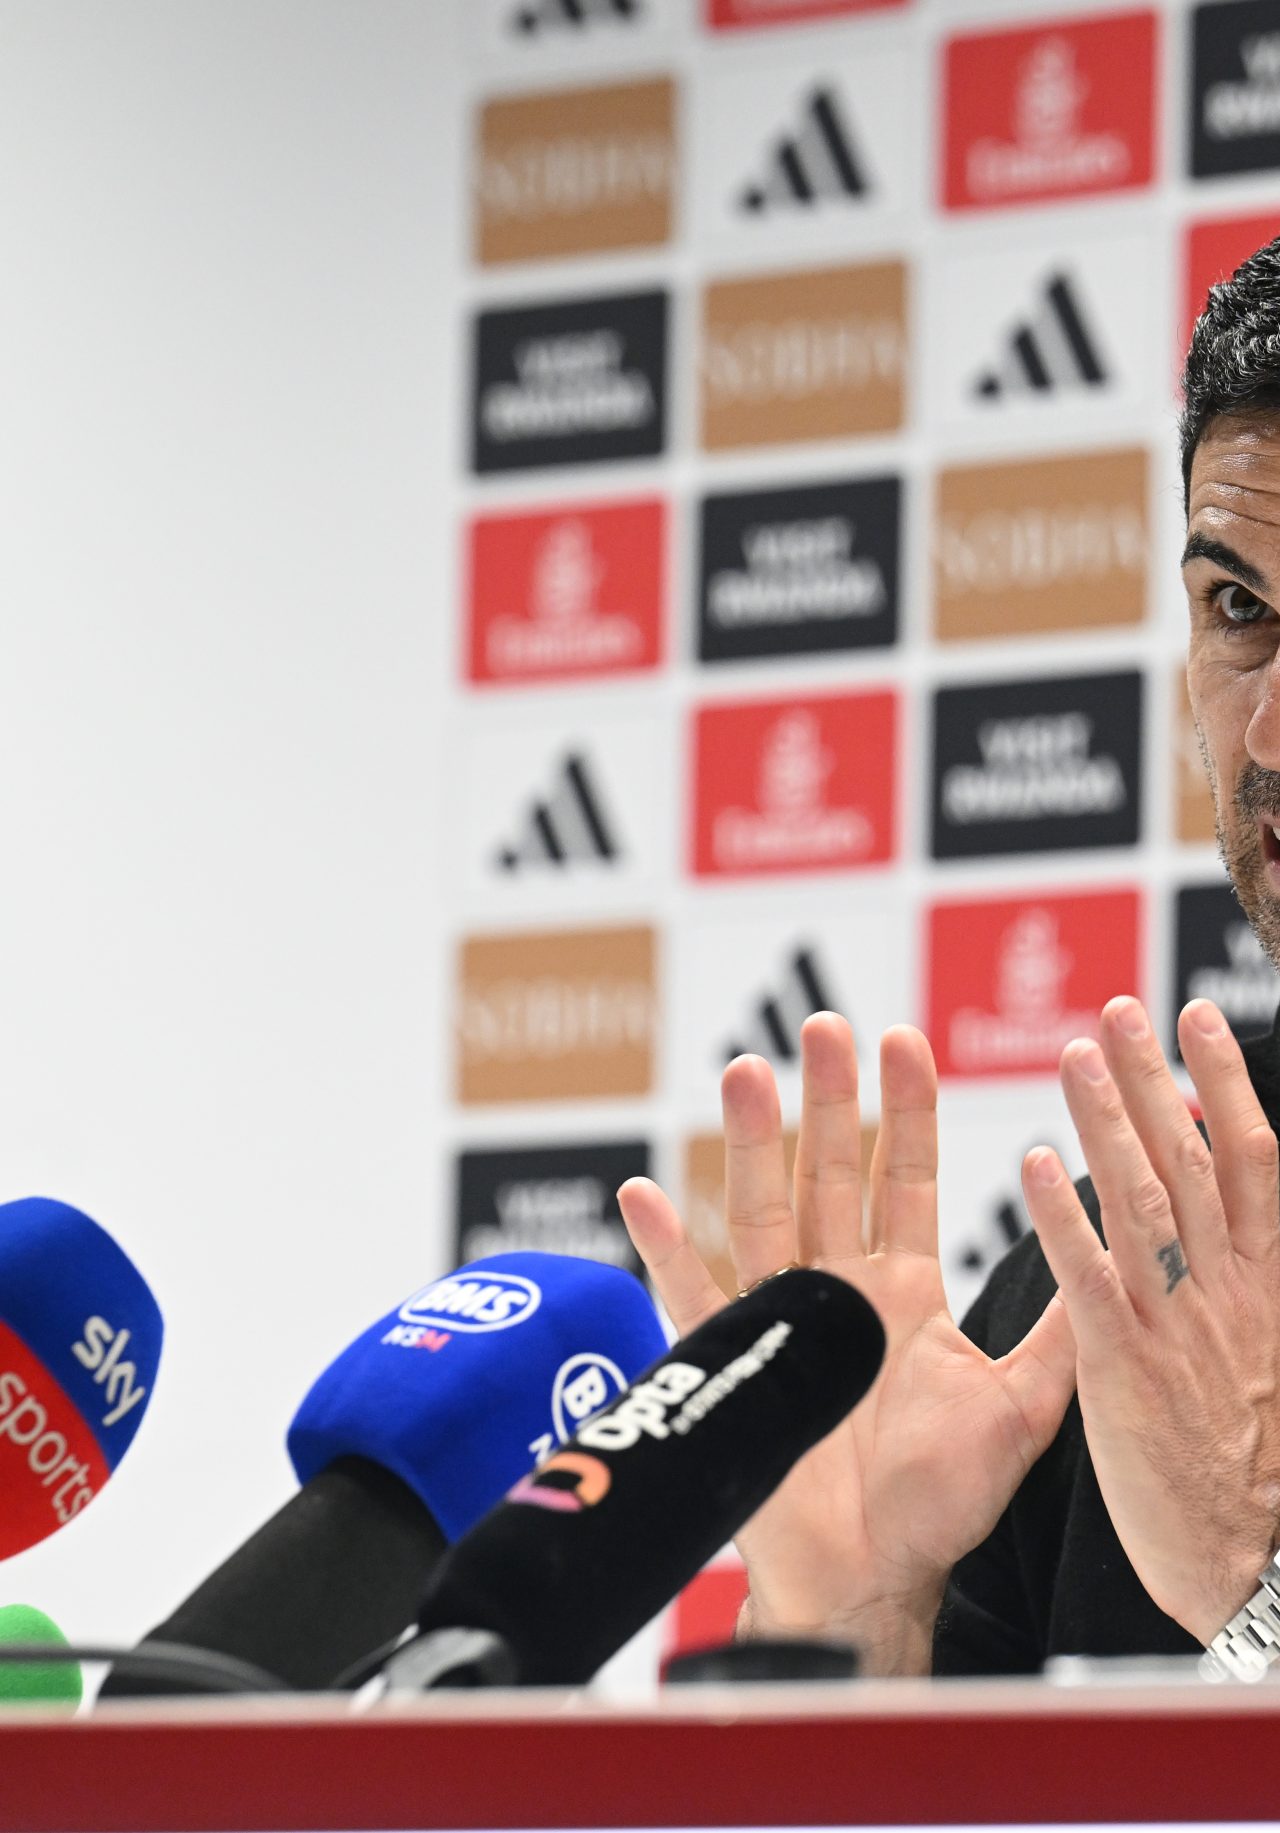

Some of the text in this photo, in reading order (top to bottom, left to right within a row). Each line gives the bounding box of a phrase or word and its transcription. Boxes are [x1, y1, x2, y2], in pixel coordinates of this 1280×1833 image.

[410, 1280, 530, 1323] BMS
[71, 1315, 146, 1427] sky
[576, 1361, 707, 1451] Opta
[0, 1372, 93, 1524] sports
